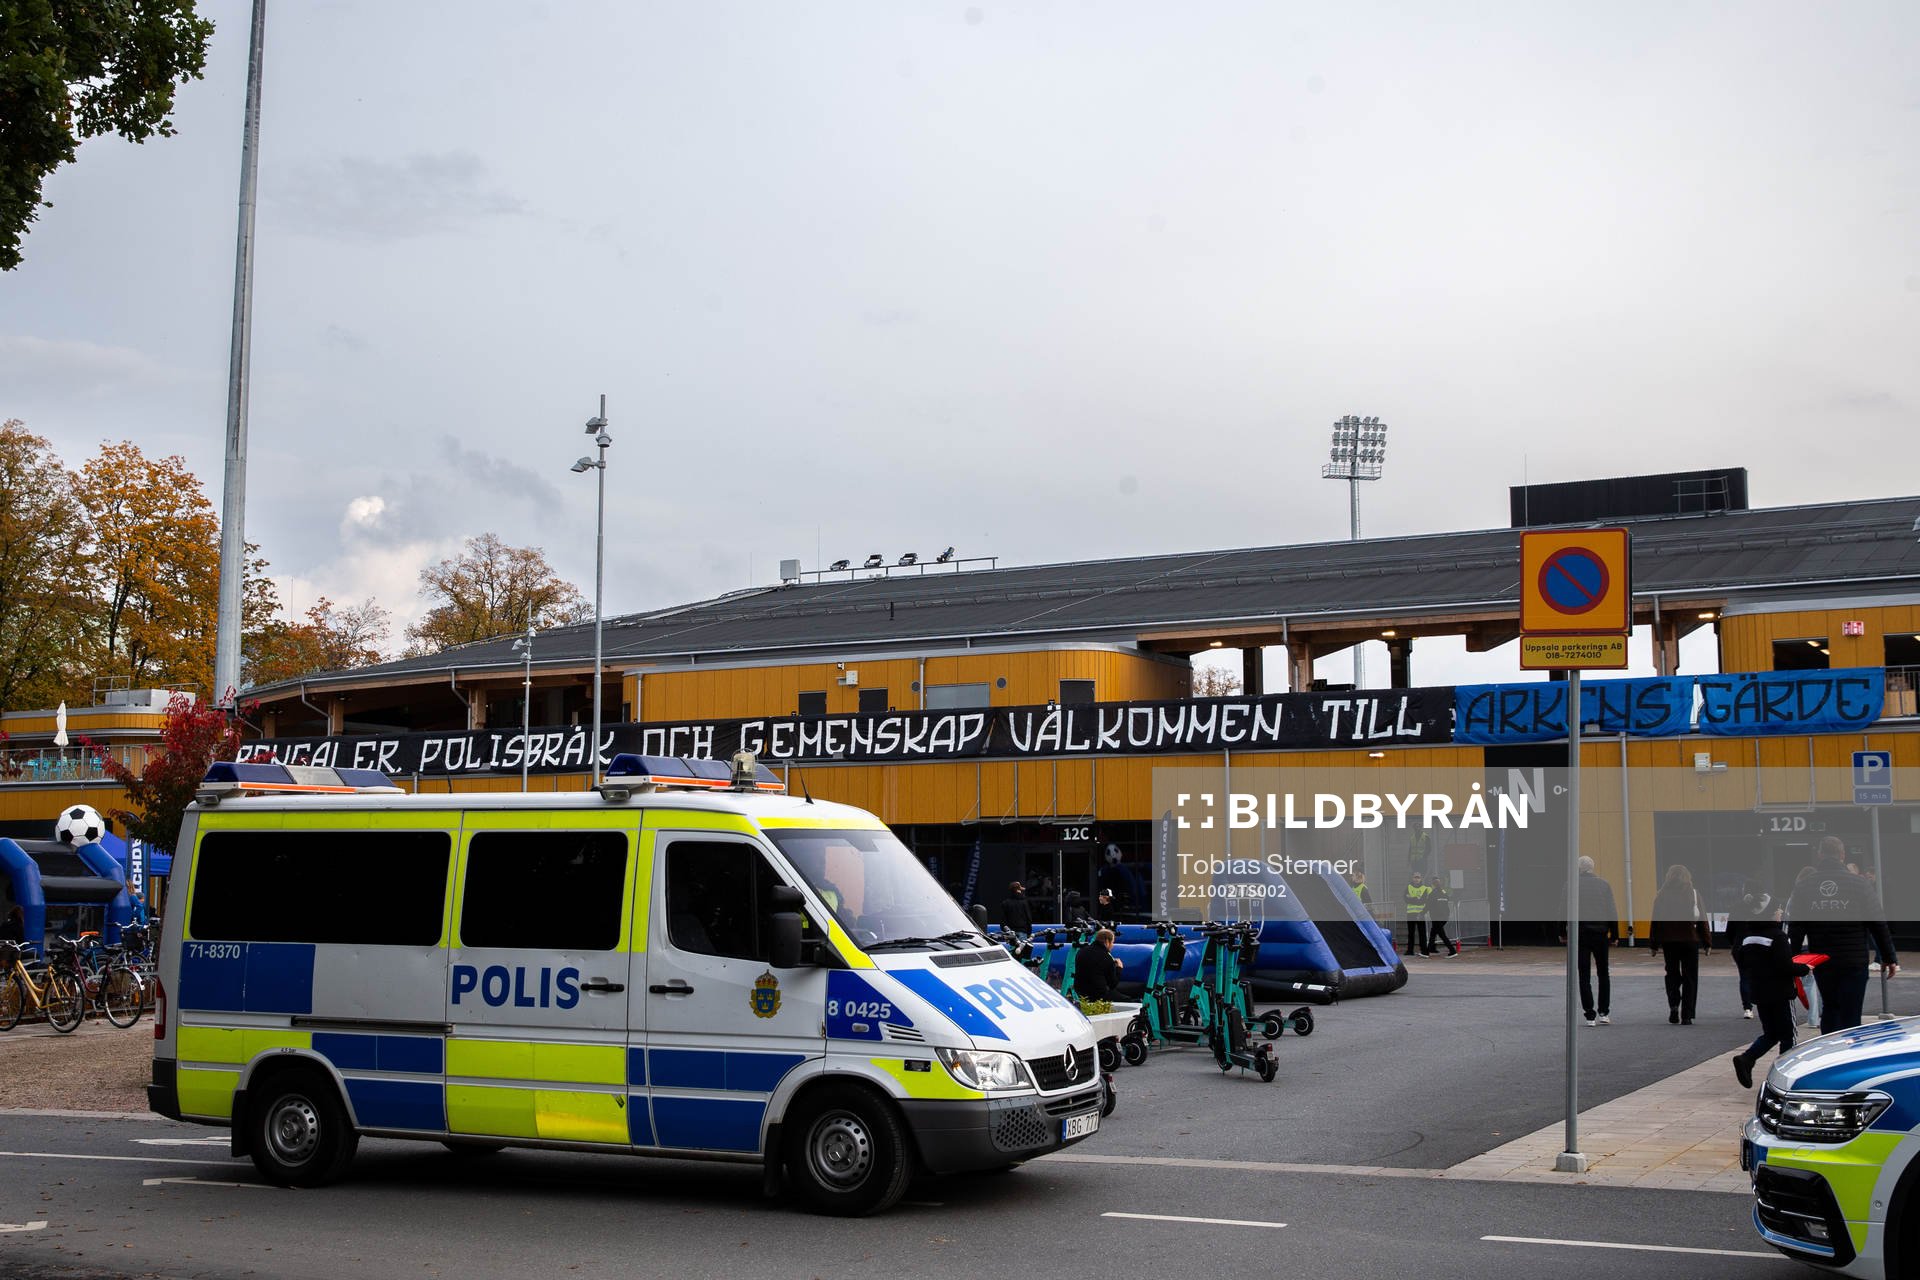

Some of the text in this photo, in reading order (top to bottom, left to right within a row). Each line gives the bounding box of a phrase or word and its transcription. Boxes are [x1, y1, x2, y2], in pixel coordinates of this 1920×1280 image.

[1525, 642, 1623, 652] Uppsala parkerings AB
[1545, 651, 1602, 660] 018-7274010
[1701, 673, 1870, 724] GÄRDE
[419, 726, 615, 771] POLISBRÅK
[642, 726, 714, 760] OCH
[740, 713, 985, 758] GEMENSKAP
[1008, 702, 1283, 753] VÄLKOMMEN
[1322, 696, 1422, 740] TILL
[1863, 755, 1884, 783] P
[1508, 768, 1545, 812] N
[1063, 827, 1089, 840] 12C
[1770, 817, 1806, 831] 12D
[190, 944, 240, 959] 71-8370
[451, 965, 580, 1010] POLIS
[845, 1001, 891, 1019] 0425
[1067, 1112, 1099, 1137] XBG 777
